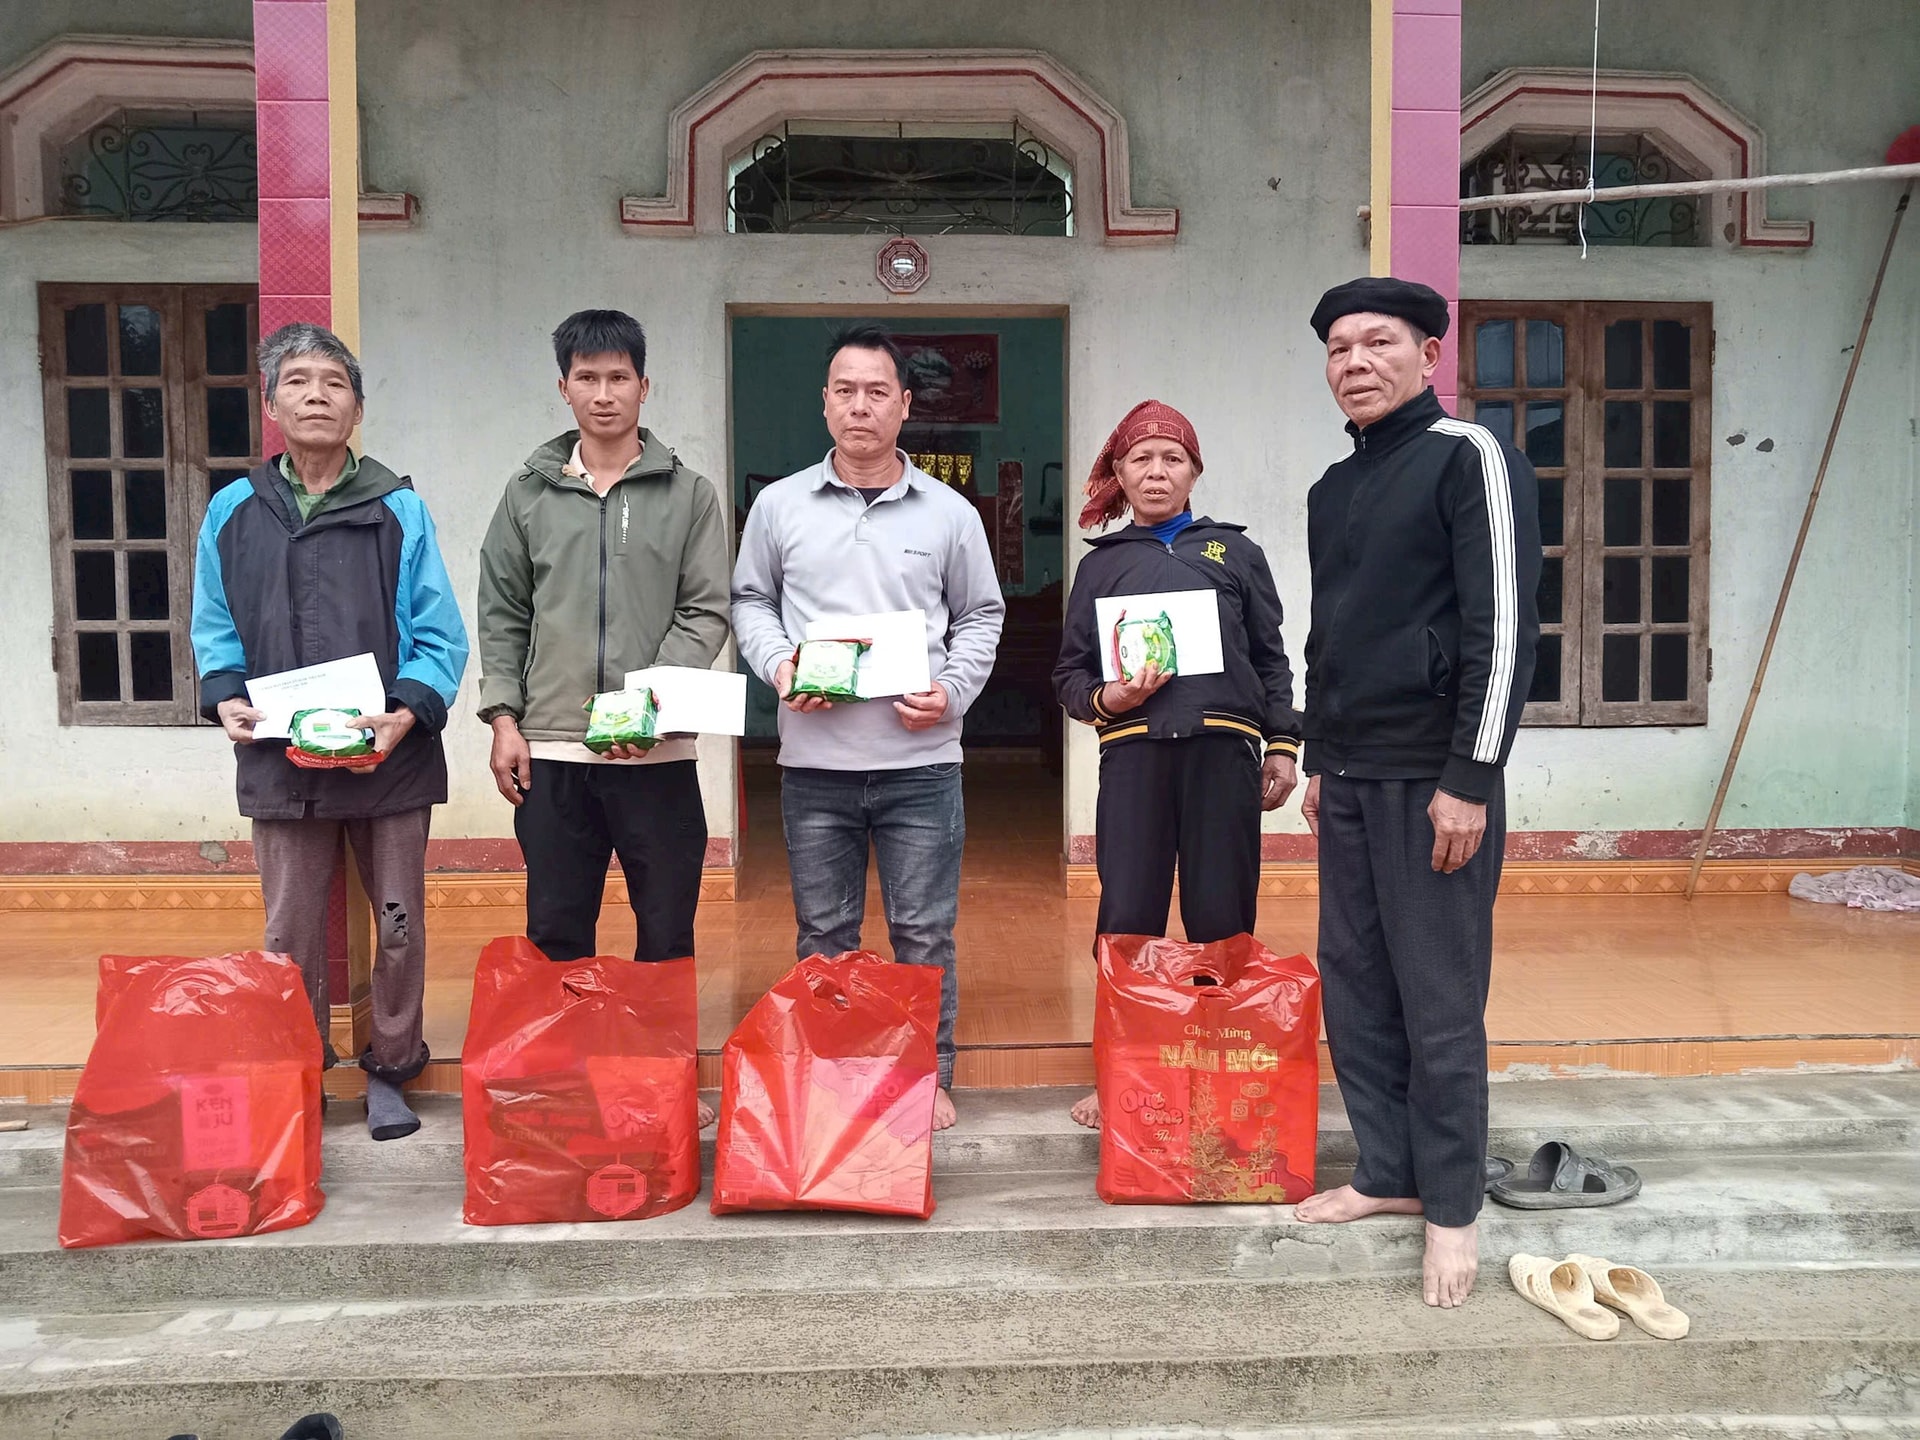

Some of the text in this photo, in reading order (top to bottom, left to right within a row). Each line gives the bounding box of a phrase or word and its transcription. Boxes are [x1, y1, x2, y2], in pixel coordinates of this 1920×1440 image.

[1159, 1039, 1279, 1073] NĂM MỚI
[196, 1096, 233, 1113] KEN
